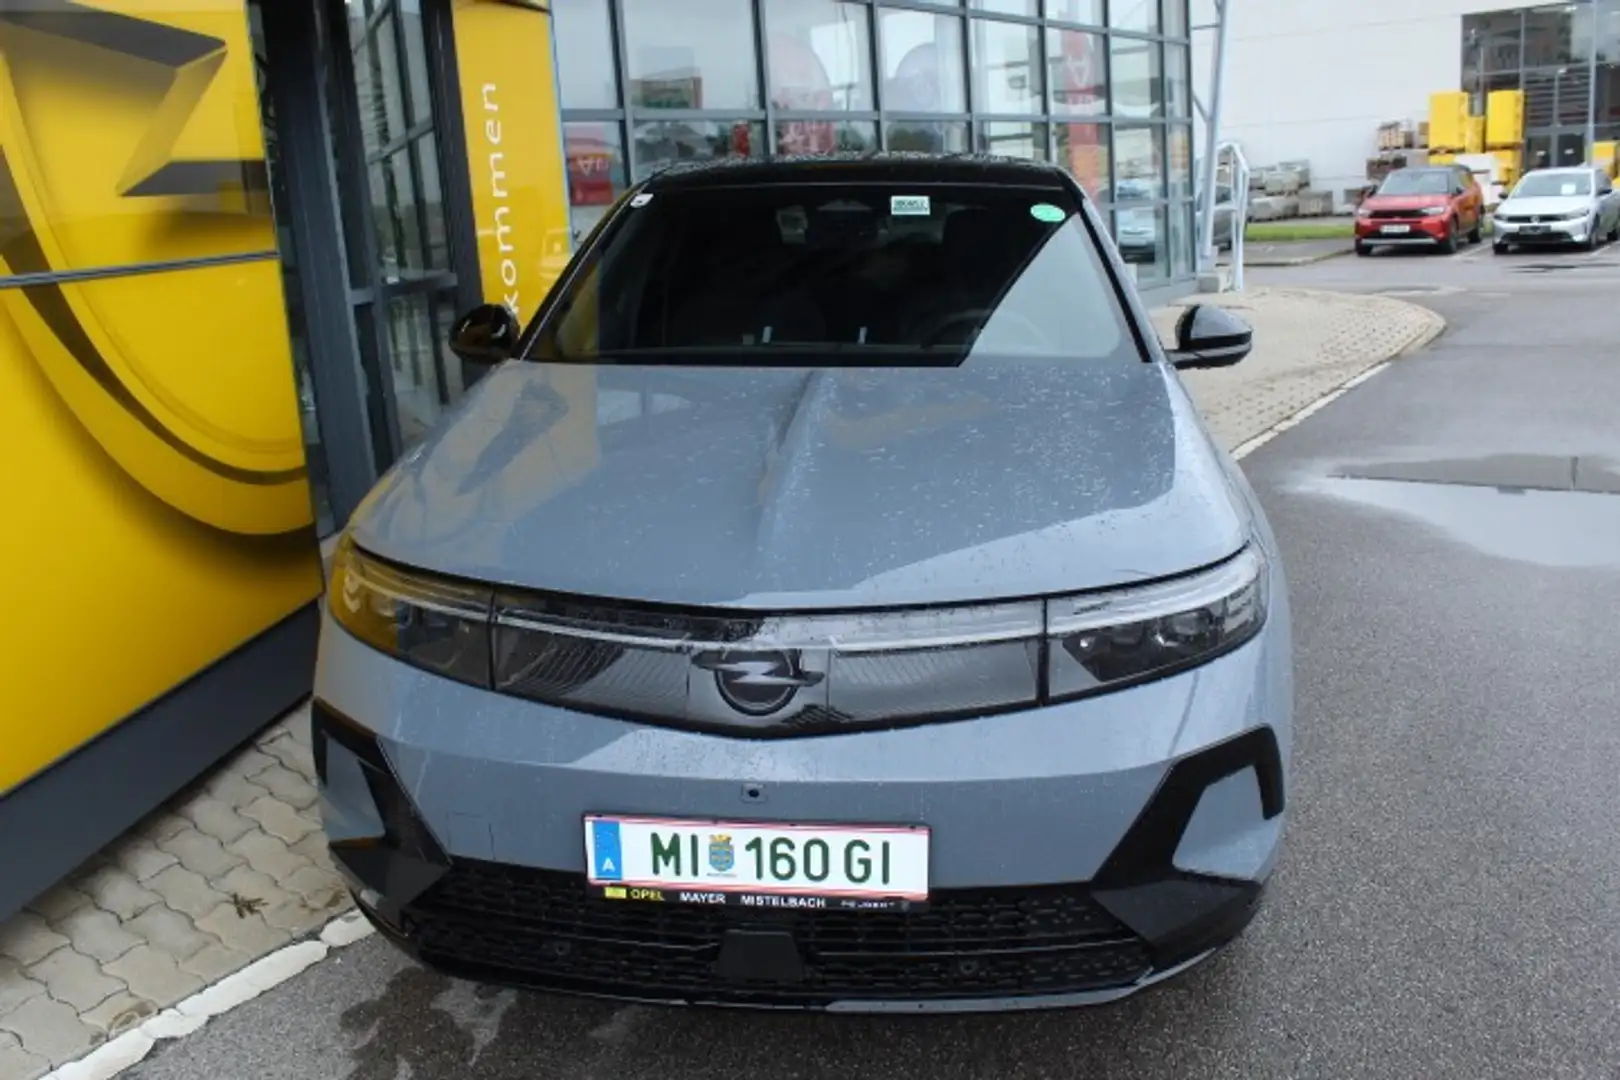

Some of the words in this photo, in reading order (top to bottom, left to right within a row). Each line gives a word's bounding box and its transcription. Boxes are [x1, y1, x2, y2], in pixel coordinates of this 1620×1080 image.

[602, 857, 615, 872] A
[650, 831, 700, 877] MI
[744, 836, 830, 883] 160
[842, 839, 892, 885] GI
[630, 888, 665, 902] OPEL
[680, 891, 726, 905] MAYER
[740, 894, 826, 909] MISTELBACH
